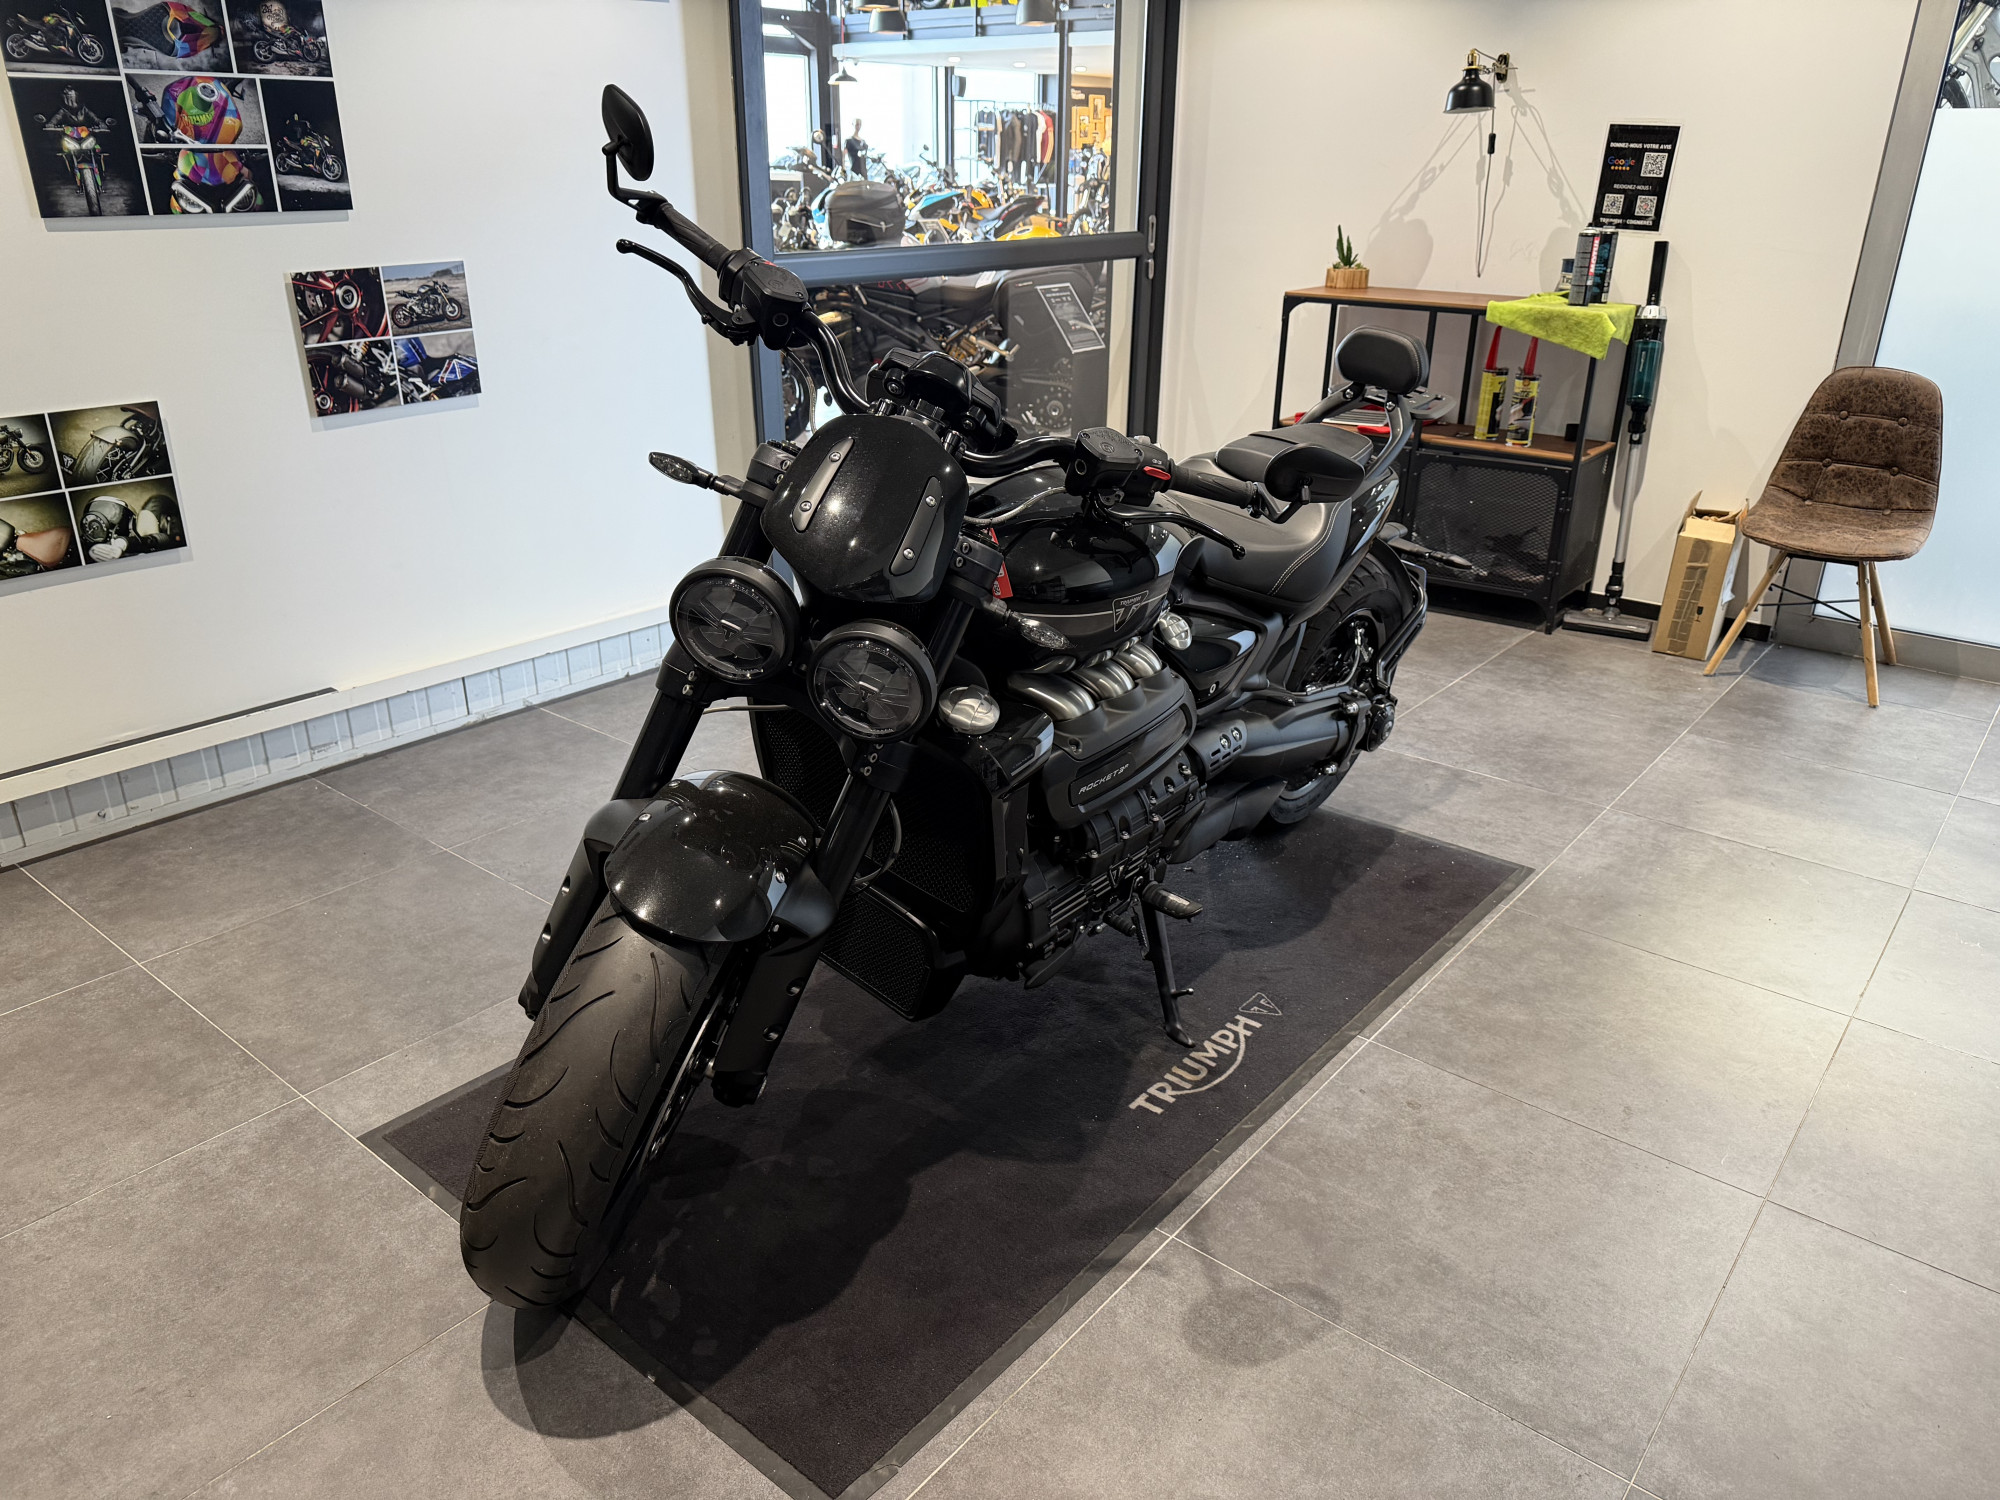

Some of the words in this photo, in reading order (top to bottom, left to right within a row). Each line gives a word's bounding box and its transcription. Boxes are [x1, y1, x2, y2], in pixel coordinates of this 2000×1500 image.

[1607, 155, 1636, 167] Google
[1590, 240, 1600, 273] MOTUL
[1128, 1014, 1263, 1115] TRIUMPH
